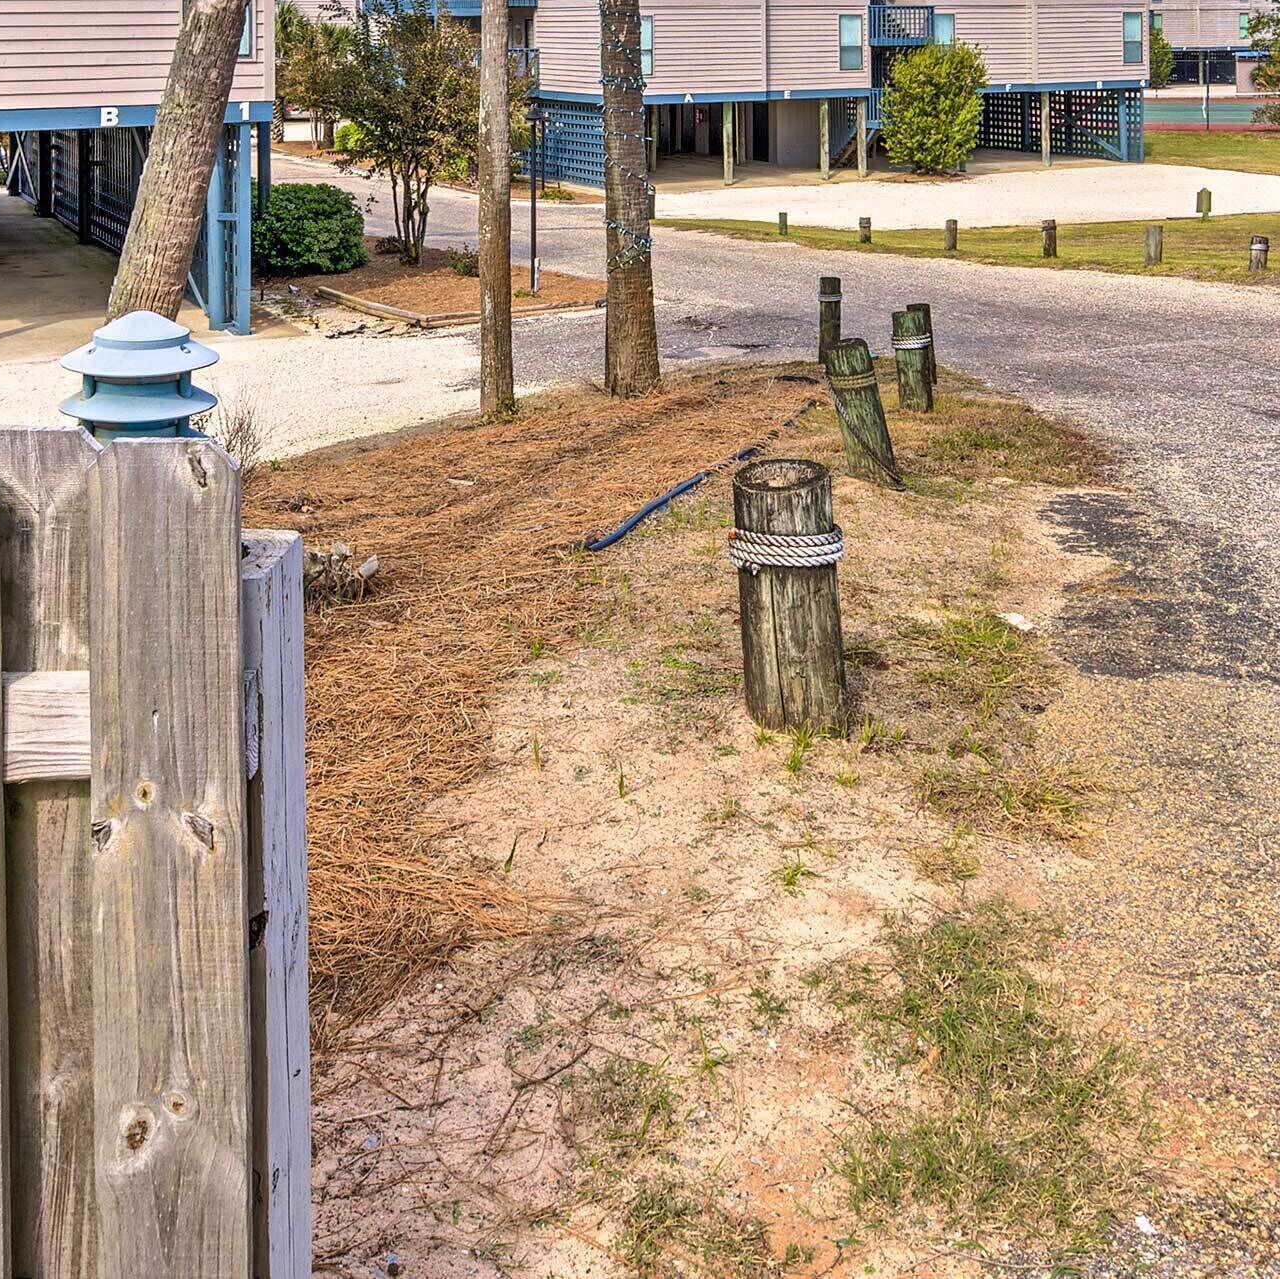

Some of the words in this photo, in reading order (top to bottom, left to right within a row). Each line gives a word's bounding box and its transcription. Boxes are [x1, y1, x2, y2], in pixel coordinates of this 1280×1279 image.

[684, 93, 694, 103] A
[784, 90, 792, 99] E
[100, 107, 119, 127] B
[239, 102, 250, 121] 1
